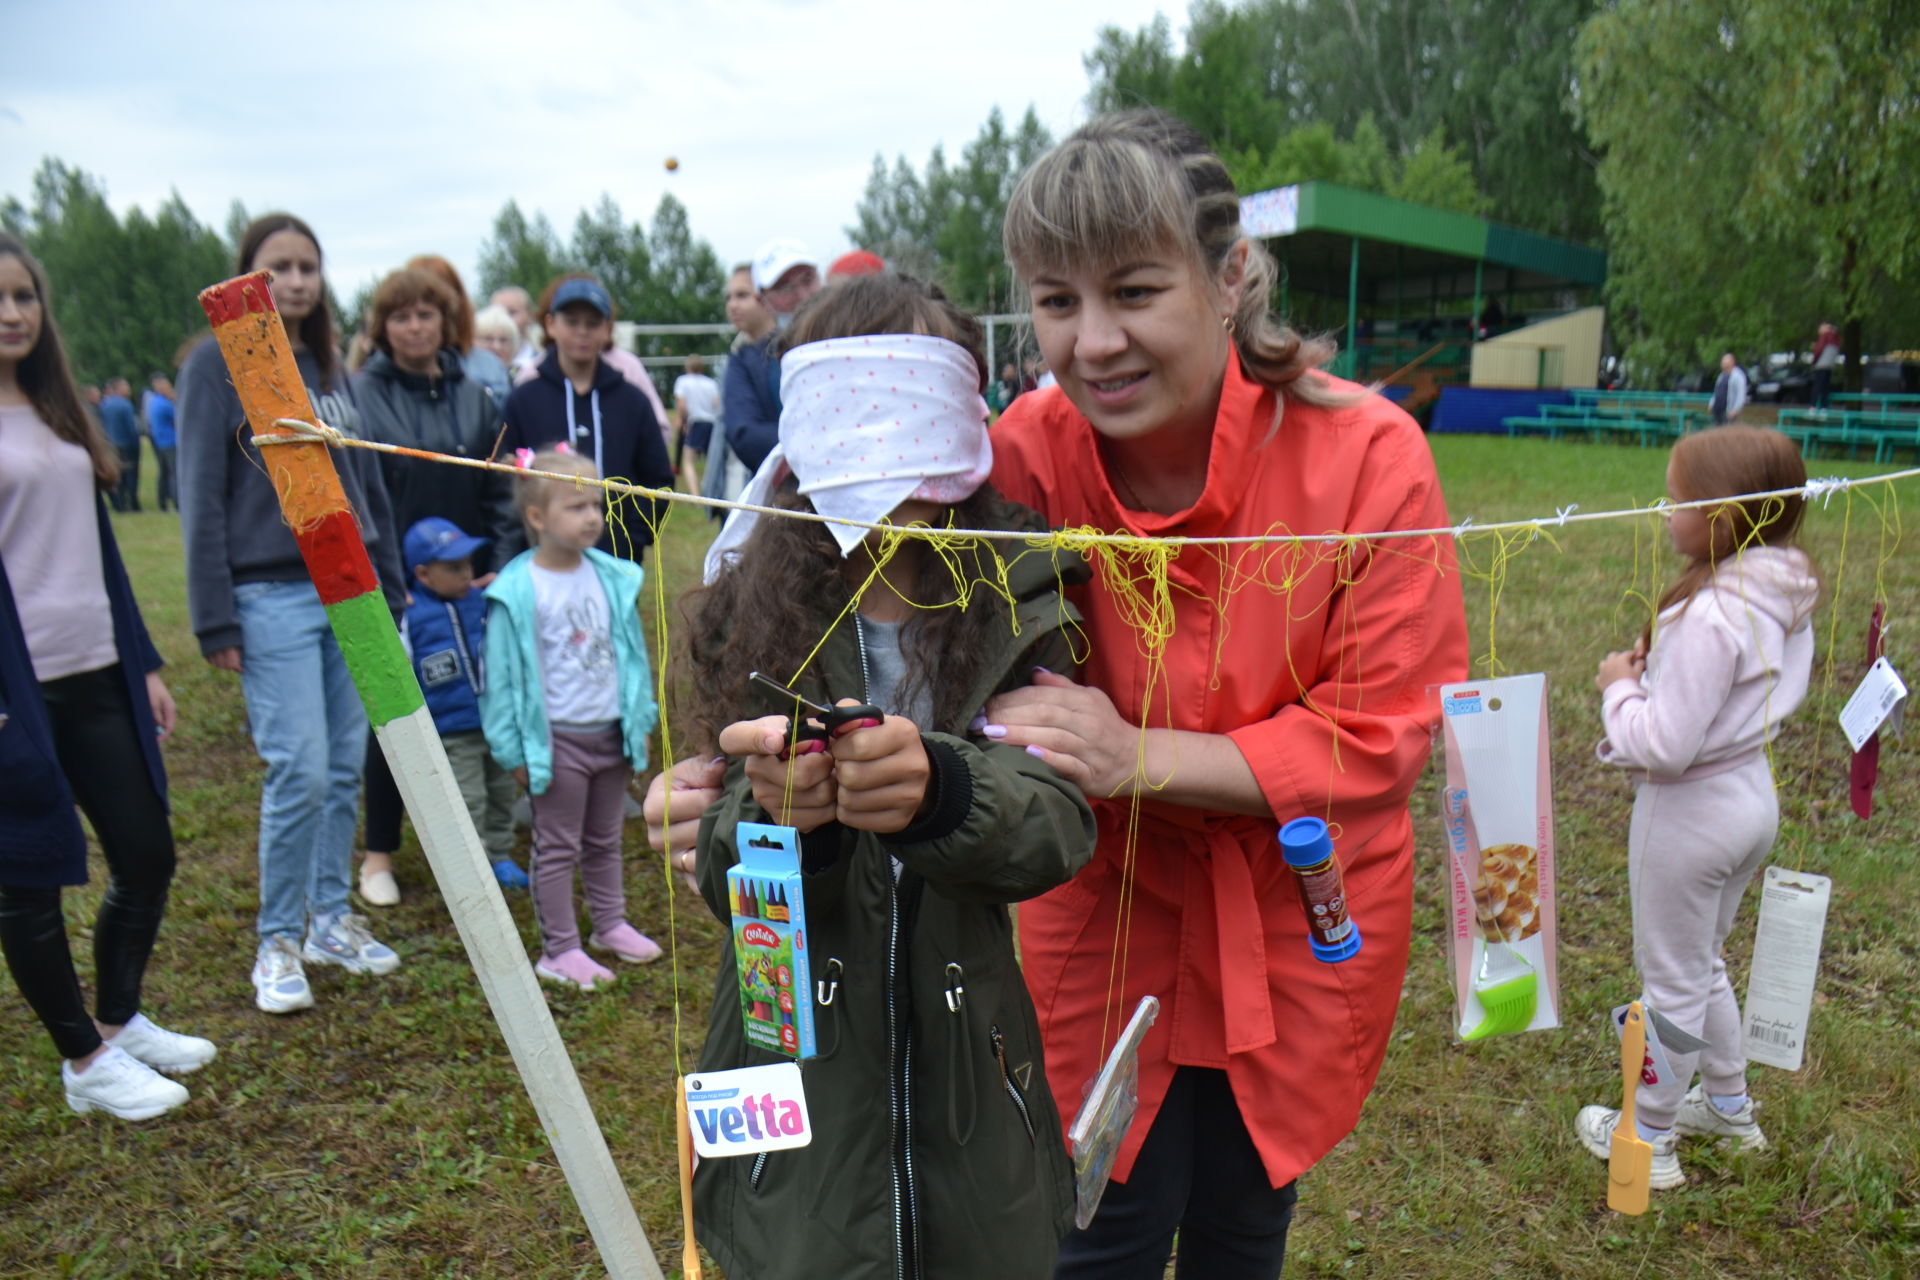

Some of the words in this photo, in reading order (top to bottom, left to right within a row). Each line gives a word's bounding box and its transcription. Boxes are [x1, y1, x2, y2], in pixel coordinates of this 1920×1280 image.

[1457, 908, 1469, 940] WARE
[784, 1029, 794, 1042] 6
[694, 1092, 804, 1144] vetta
